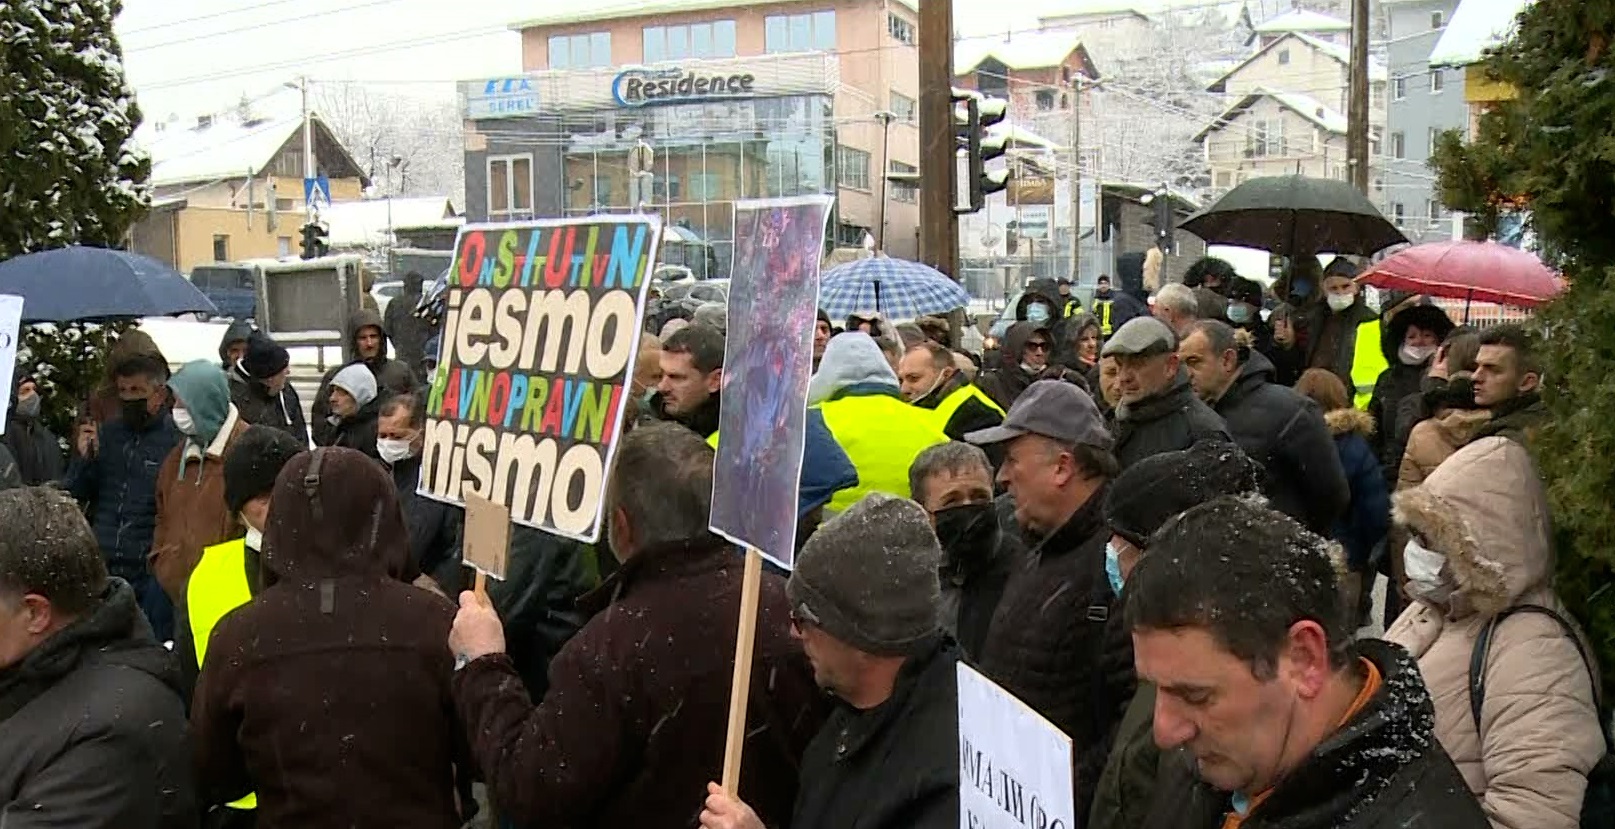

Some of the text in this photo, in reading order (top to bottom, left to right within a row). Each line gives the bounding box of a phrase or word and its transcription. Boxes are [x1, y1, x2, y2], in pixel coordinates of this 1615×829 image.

[626, 71, 756, 101] Residence
[448, 222, 648, 289] KONSTITUTIVNI
[441, 287, 636, 379] jesmo
[427, 364, 623, 446] RAVNOPRAVNI
[423, 419, 603, 535] nismo
